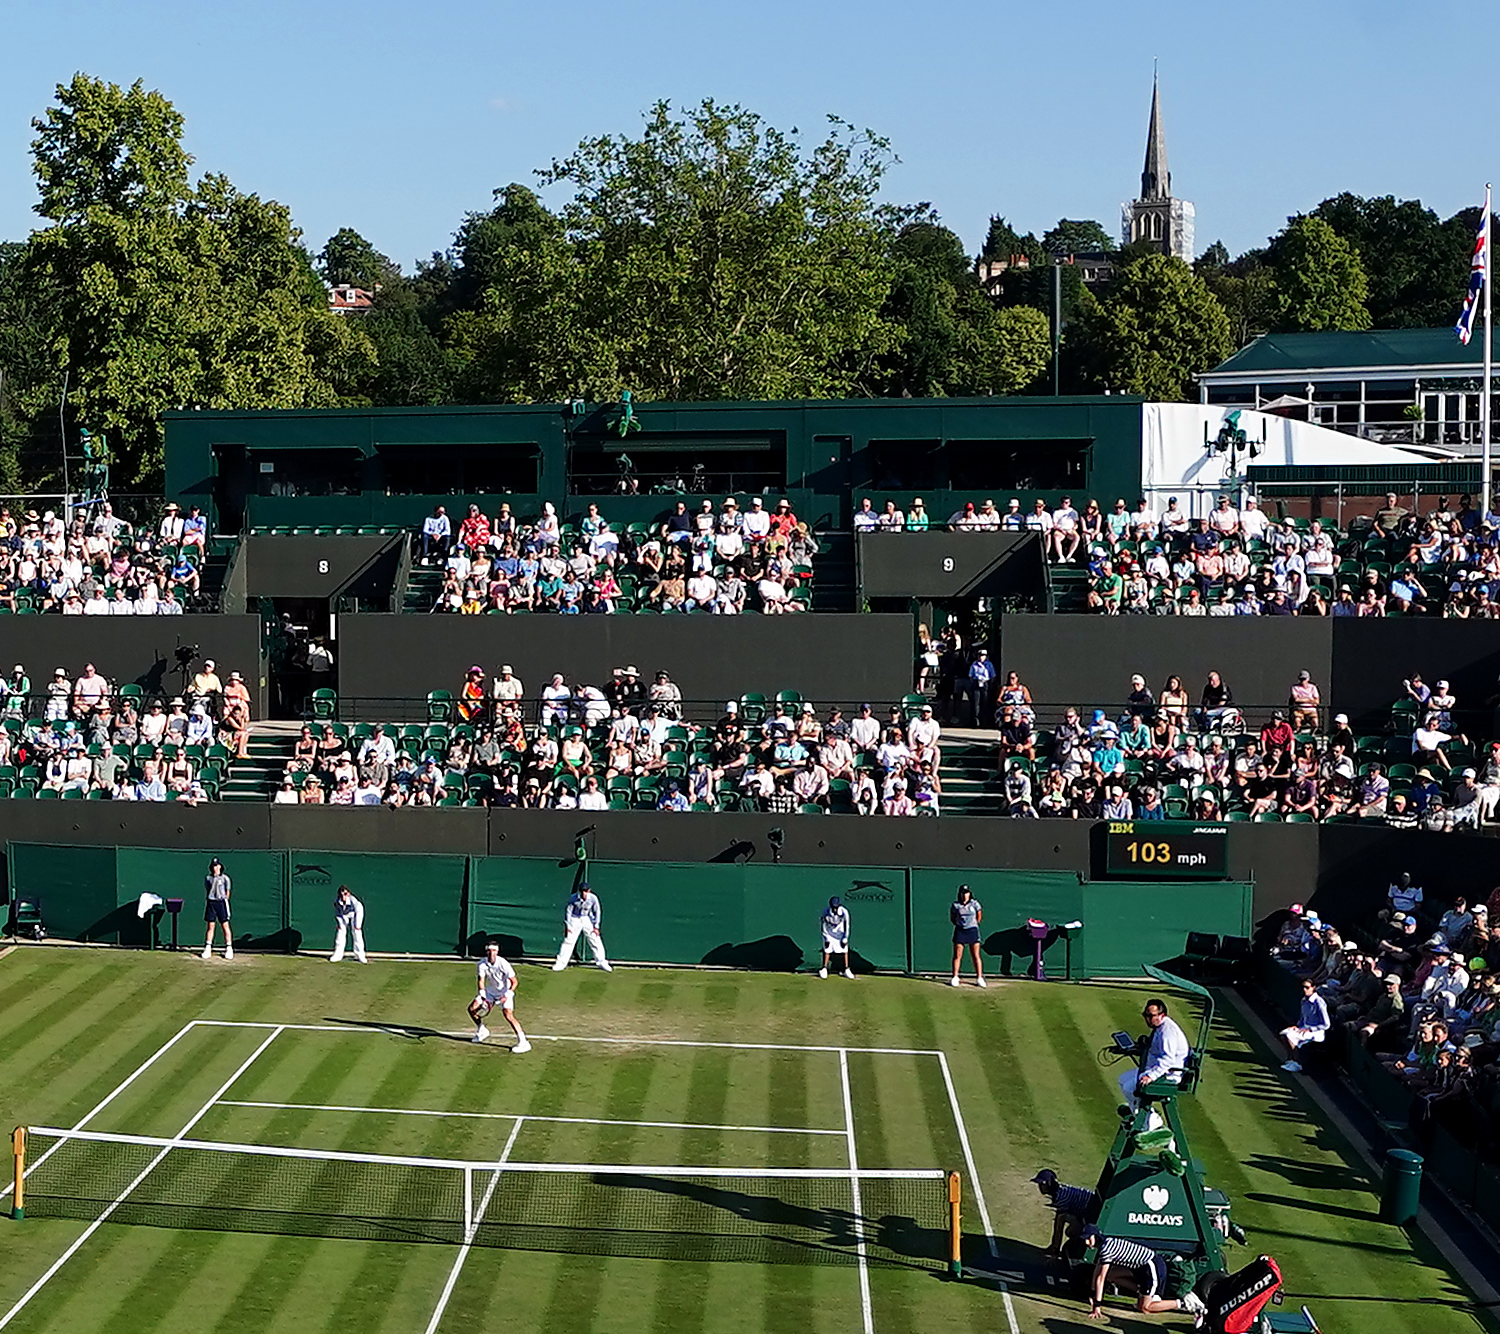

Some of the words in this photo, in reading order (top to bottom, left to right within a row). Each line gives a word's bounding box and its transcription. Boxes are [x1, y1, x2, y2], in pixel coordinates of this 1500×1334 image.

[318, 560, 329, 574] 8
[943, 557, 954, 572] 9
[1108, 822, 1134, 834] IBM
[1126, 841, 1171, 863] 103
[1177, 852, 1206, 866] mph
[1128, 1212, 1184, 1227] BARCLAYS
[1219, 1273, 1273, 1316] DUNLOP
